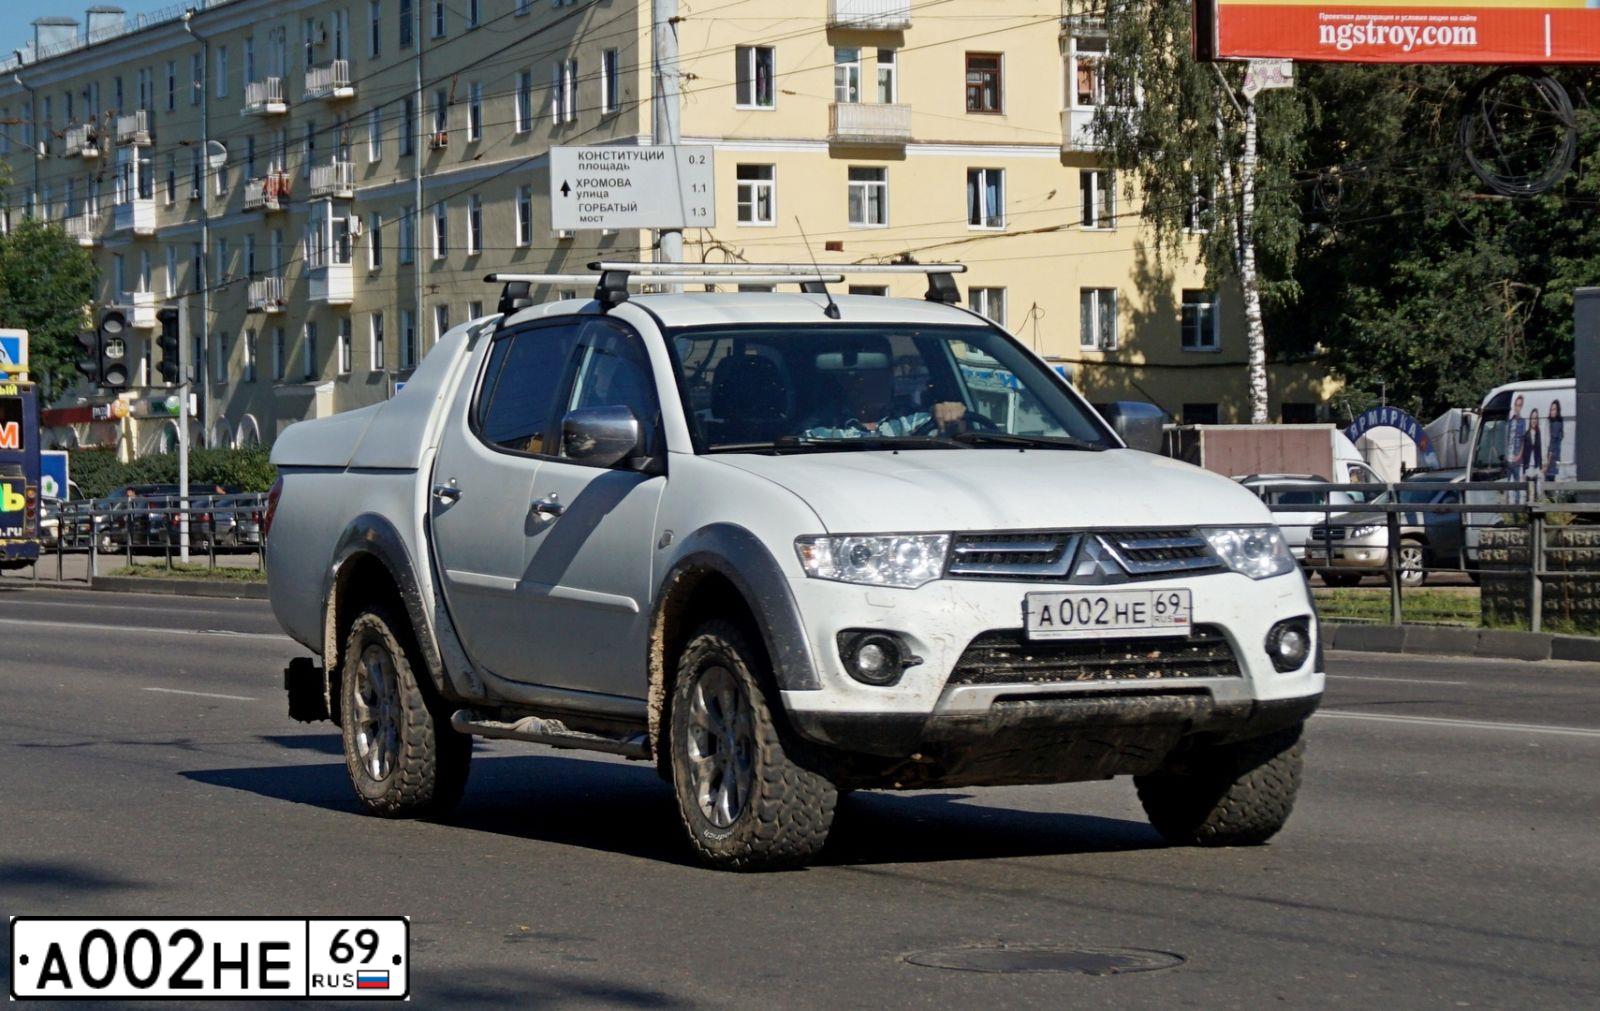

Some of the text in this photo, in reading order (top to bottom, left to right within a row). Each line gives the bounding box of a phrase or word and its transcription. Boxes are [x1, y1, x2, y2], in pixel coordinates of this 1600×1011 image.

[1319, 19, 1477, 51] ngstroy.com
[577, 151, 665, 162] КОНСТИТУЦИИ
[688, 155, 706, 165] 0.2
[578, 162, 631, 171] площадь
[576, 178, 632, 188] ХРОМОВА
[692, 183, 706, 193] 1.1
[576, 190, 609, 200] улица
[578, 201, 638, 212] ГОРБАТЫЙ
[692, 207, 707, 217] 1.3
[1350, 408, 1417, 440] ЯРМАРКА
[1154, 593, 1180, 614] 69
[1154, 615, 1173, 623] RUS
